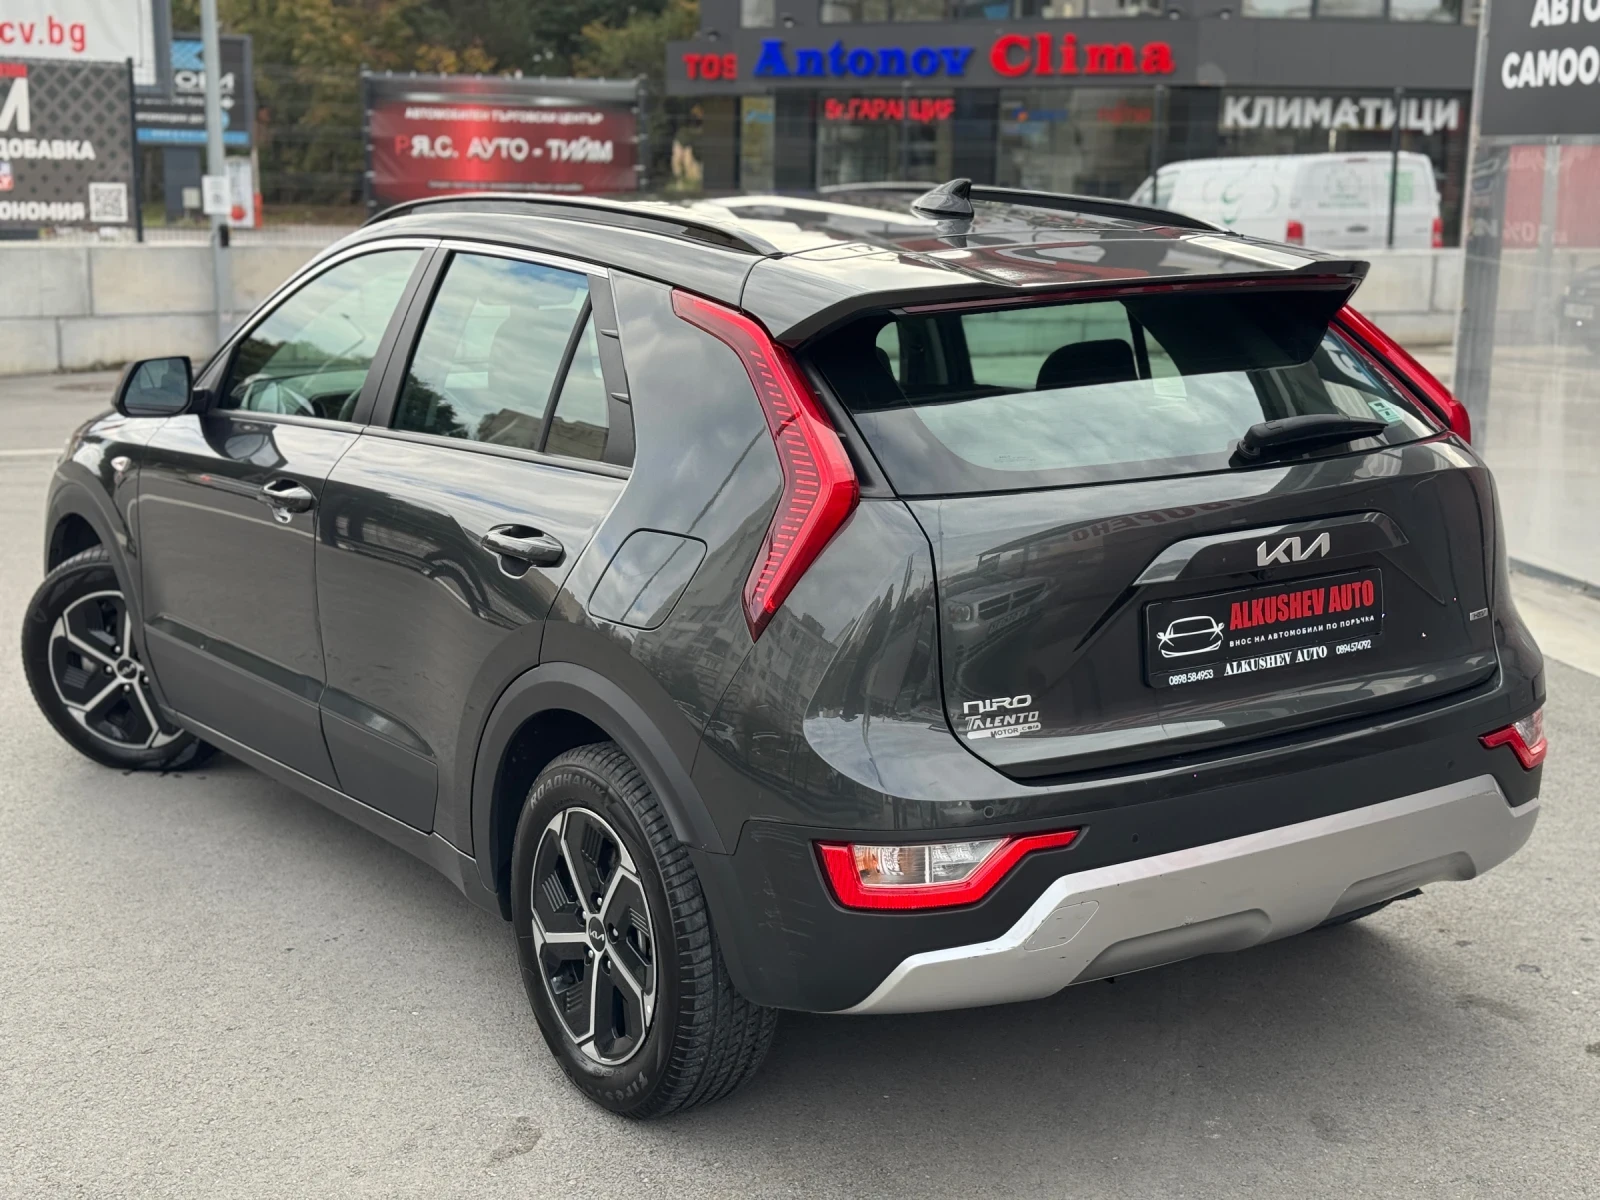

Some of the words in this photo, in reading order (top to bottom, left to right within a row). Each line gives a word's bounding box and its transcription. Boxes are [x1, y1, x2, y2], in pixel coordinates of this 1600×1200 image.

[753, 37, 975, 77] Antonov
[990, 32, 1176, 78] Clima
[1222, 96, 1460, 135] КЛИМАТИЦИ
[466, 136, 530, 163] АУТО
[1229, 587, 1325, 631] ALKUSHEV
[1328, 579, 1374, 614] AUTO
[1229, 637, 1252, 648] ВНОС
[1254, 634, 1266, 643] НА
[1267, 624, 1324, 641] АВТОМОБИЛИ
[1326, 622, 1338, 631] ПО
[1339, 614, 1375, 628] ПОРЪЧКА
[1224, 652, 1293, 677] ALKUSHEV
[1295, 645, 1328, 663] AUTO
[965, 711, 1039, 730] TALENTO
